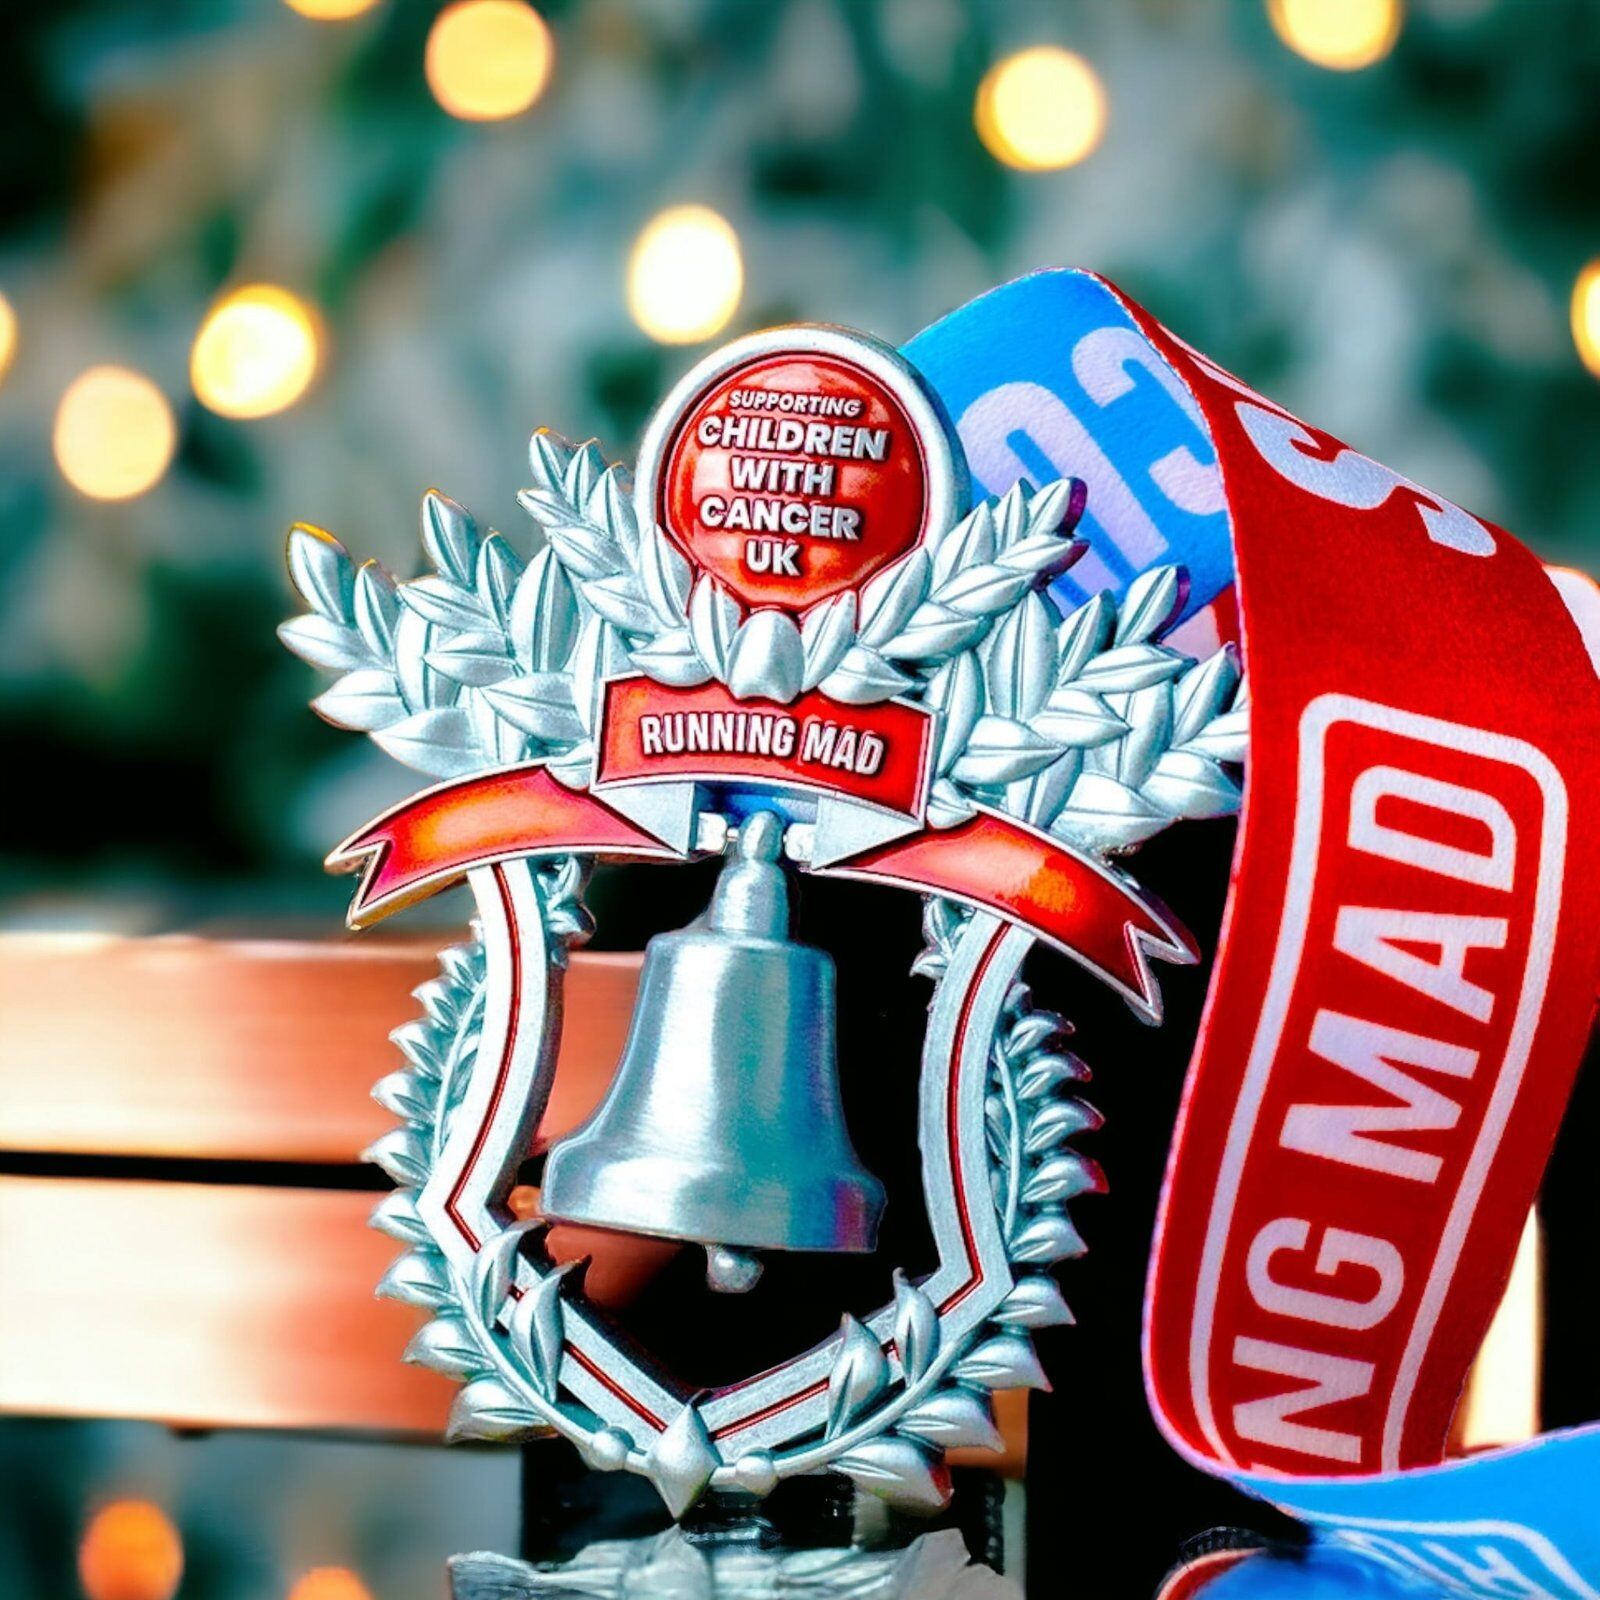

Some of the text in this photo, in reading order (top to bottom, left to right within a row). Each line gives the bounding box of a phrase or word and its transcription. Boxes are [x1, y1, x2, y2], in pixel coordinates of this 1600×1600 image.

[729, 389, 863, 418] SUPPORTING
[698, 414, 890, 462] CHILDREN
[730, 455, 835, 497] WITH
[700, 496, 862, 541] CANCER
[745, 539, 801, 577] UK
[639, 711, 885, 776] RUNNING MAD
[1231, 763, 1518, 1475] NG MAD
